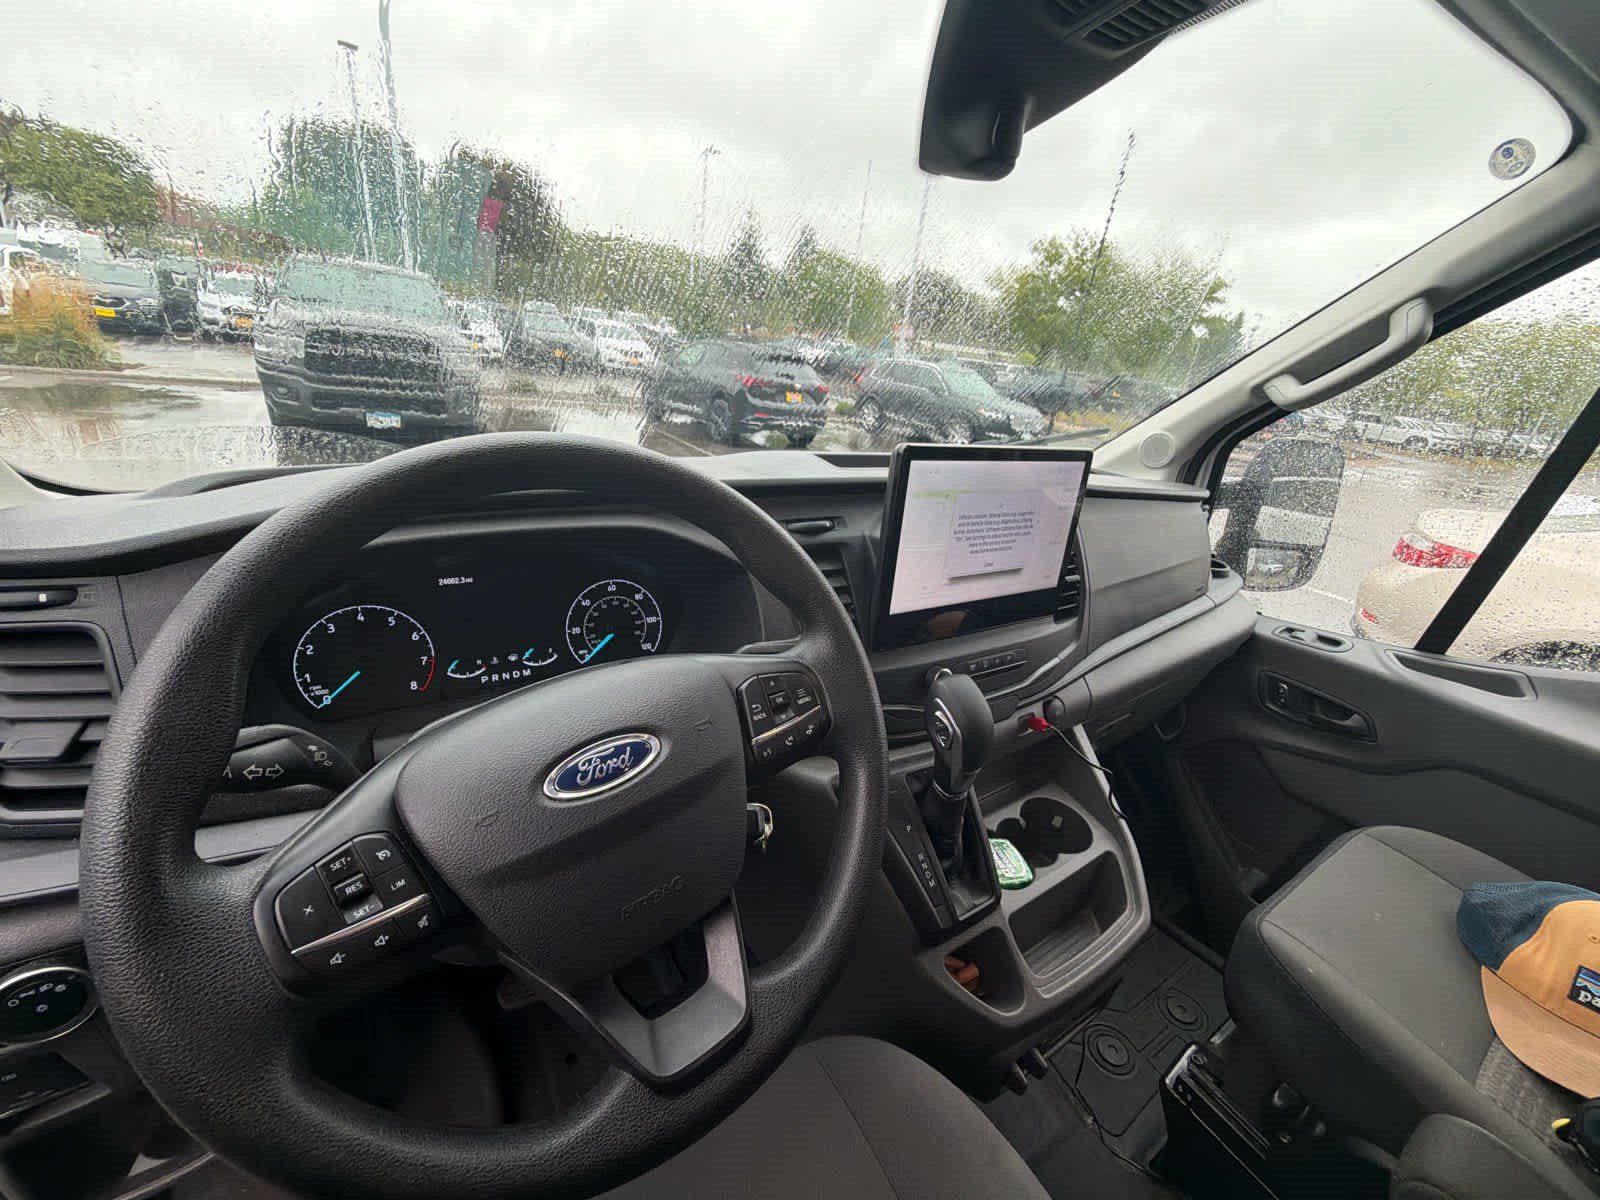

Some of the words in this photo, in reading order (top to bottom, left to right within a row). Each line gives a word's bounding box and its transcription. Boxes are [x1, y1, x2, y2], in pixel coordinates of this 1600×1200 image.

[607, 584, 616, 592] 60
[357, 611, 365, 622] 4
[388, 616, 395, 626] 5
[327, 623, 336, 633] 3
[571, 626, 581, 635] 20
[411, 631, 420, 641] 6
[305, 644, 314, 655] 2
[420, 656, 428, 665] 7
[304, 673, 311, 683] 1
[481, 675, 488, 683] P
[492, 673, 499, 681] R
[512, 670, 520, 678] D
[523, 668, 531, 676] M
[410, 680, 418, 690] 8
[576, 746, 634, 785] Ford
[344, 881, 363, 895] RES
[390, 879, 406, 891] LIM
